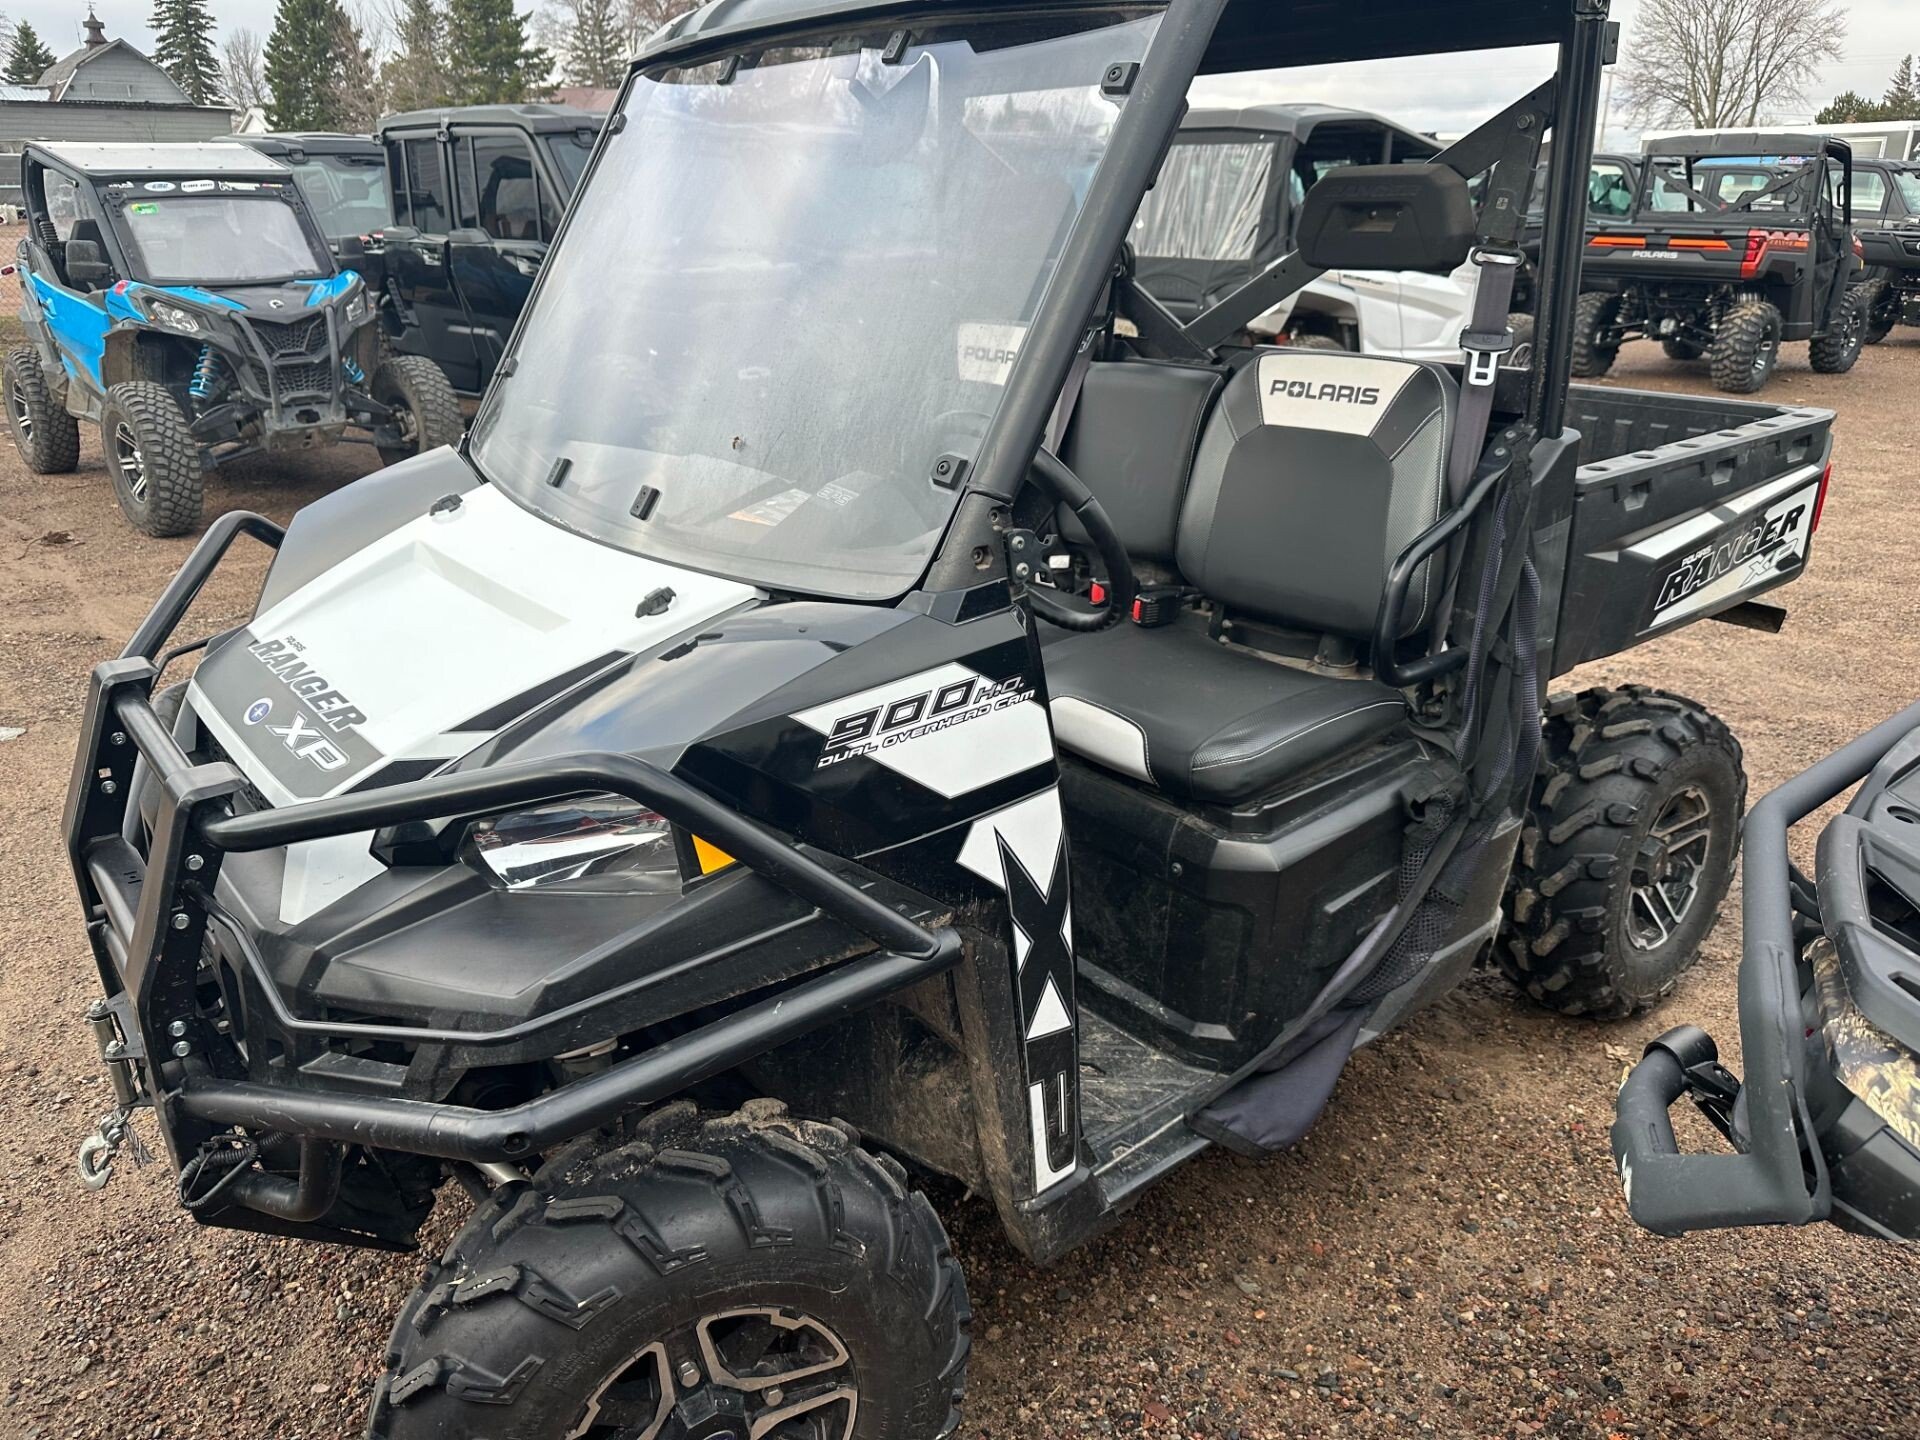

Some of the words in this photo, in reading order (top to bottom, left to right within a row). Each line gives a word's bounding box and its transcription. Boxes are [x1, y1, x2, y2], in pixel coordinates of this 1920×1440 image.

[1632, 251, 1678, 259] POLARIS
[964, 345, 1016, 364] POLAR
[1269, 379, 1380, 406] POLARIS
[1654, 503, 1806, 610] RANGER
[1681, 545, 1713, 568] POLARIS
[1737, 537, 1799, 590] XP
[285, 635, 306, 652] POLARIS
[248, 639, 367, 732] RANGER
[816, 742, 878, 768] DUAL
[883, 704, 992, 748] OVERHEAD
[994, 688, 1036, 712] CAM
[824, 675, 980, 750] 900
[265, 711, 350, 772] XP
